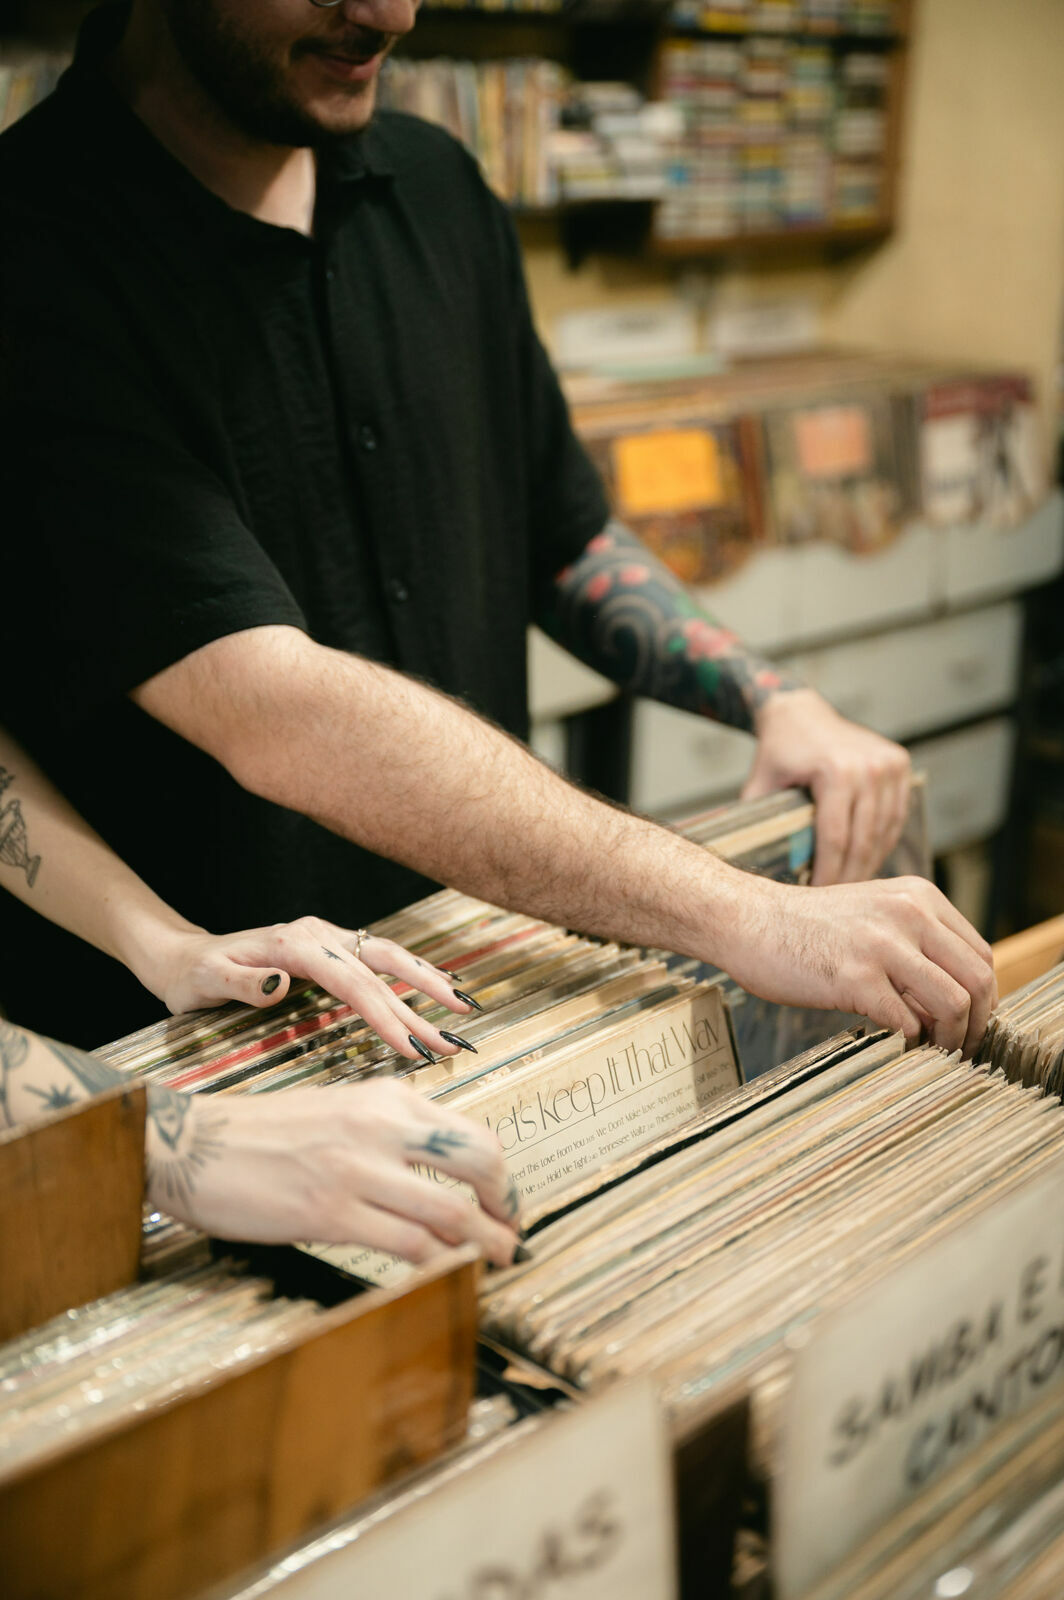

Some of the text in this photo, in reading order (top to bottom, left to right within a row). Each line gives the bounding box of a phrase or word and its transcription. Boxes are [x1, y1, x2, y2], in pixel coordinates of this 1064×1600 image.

[537, 1072, 606, 1131] Keep
[606, 1056, 626, 1095] It
[616, 1032, 676, 1086] That
[527, 1162, 540, 1175] This
[540, 1153, 556, 1168] Love
[556, 1144, 573, 1160] From
[572, 1139, 586, 1152] You
[596, 1126, 607, 1137] We
[607, 1116, 625, 1132] Don't
[625, 1107, 640, 1121] Make
[641, 1102, 656, 1115] Love
[546, 1169, 562, 1184] Hold
[562, 1163, 573, 1175] Me
[573, 1155, 589, 1170] Tight
[598, 1134, 630, 1154] Tennessee
[630, 1124, 646, 1138] Waltz
